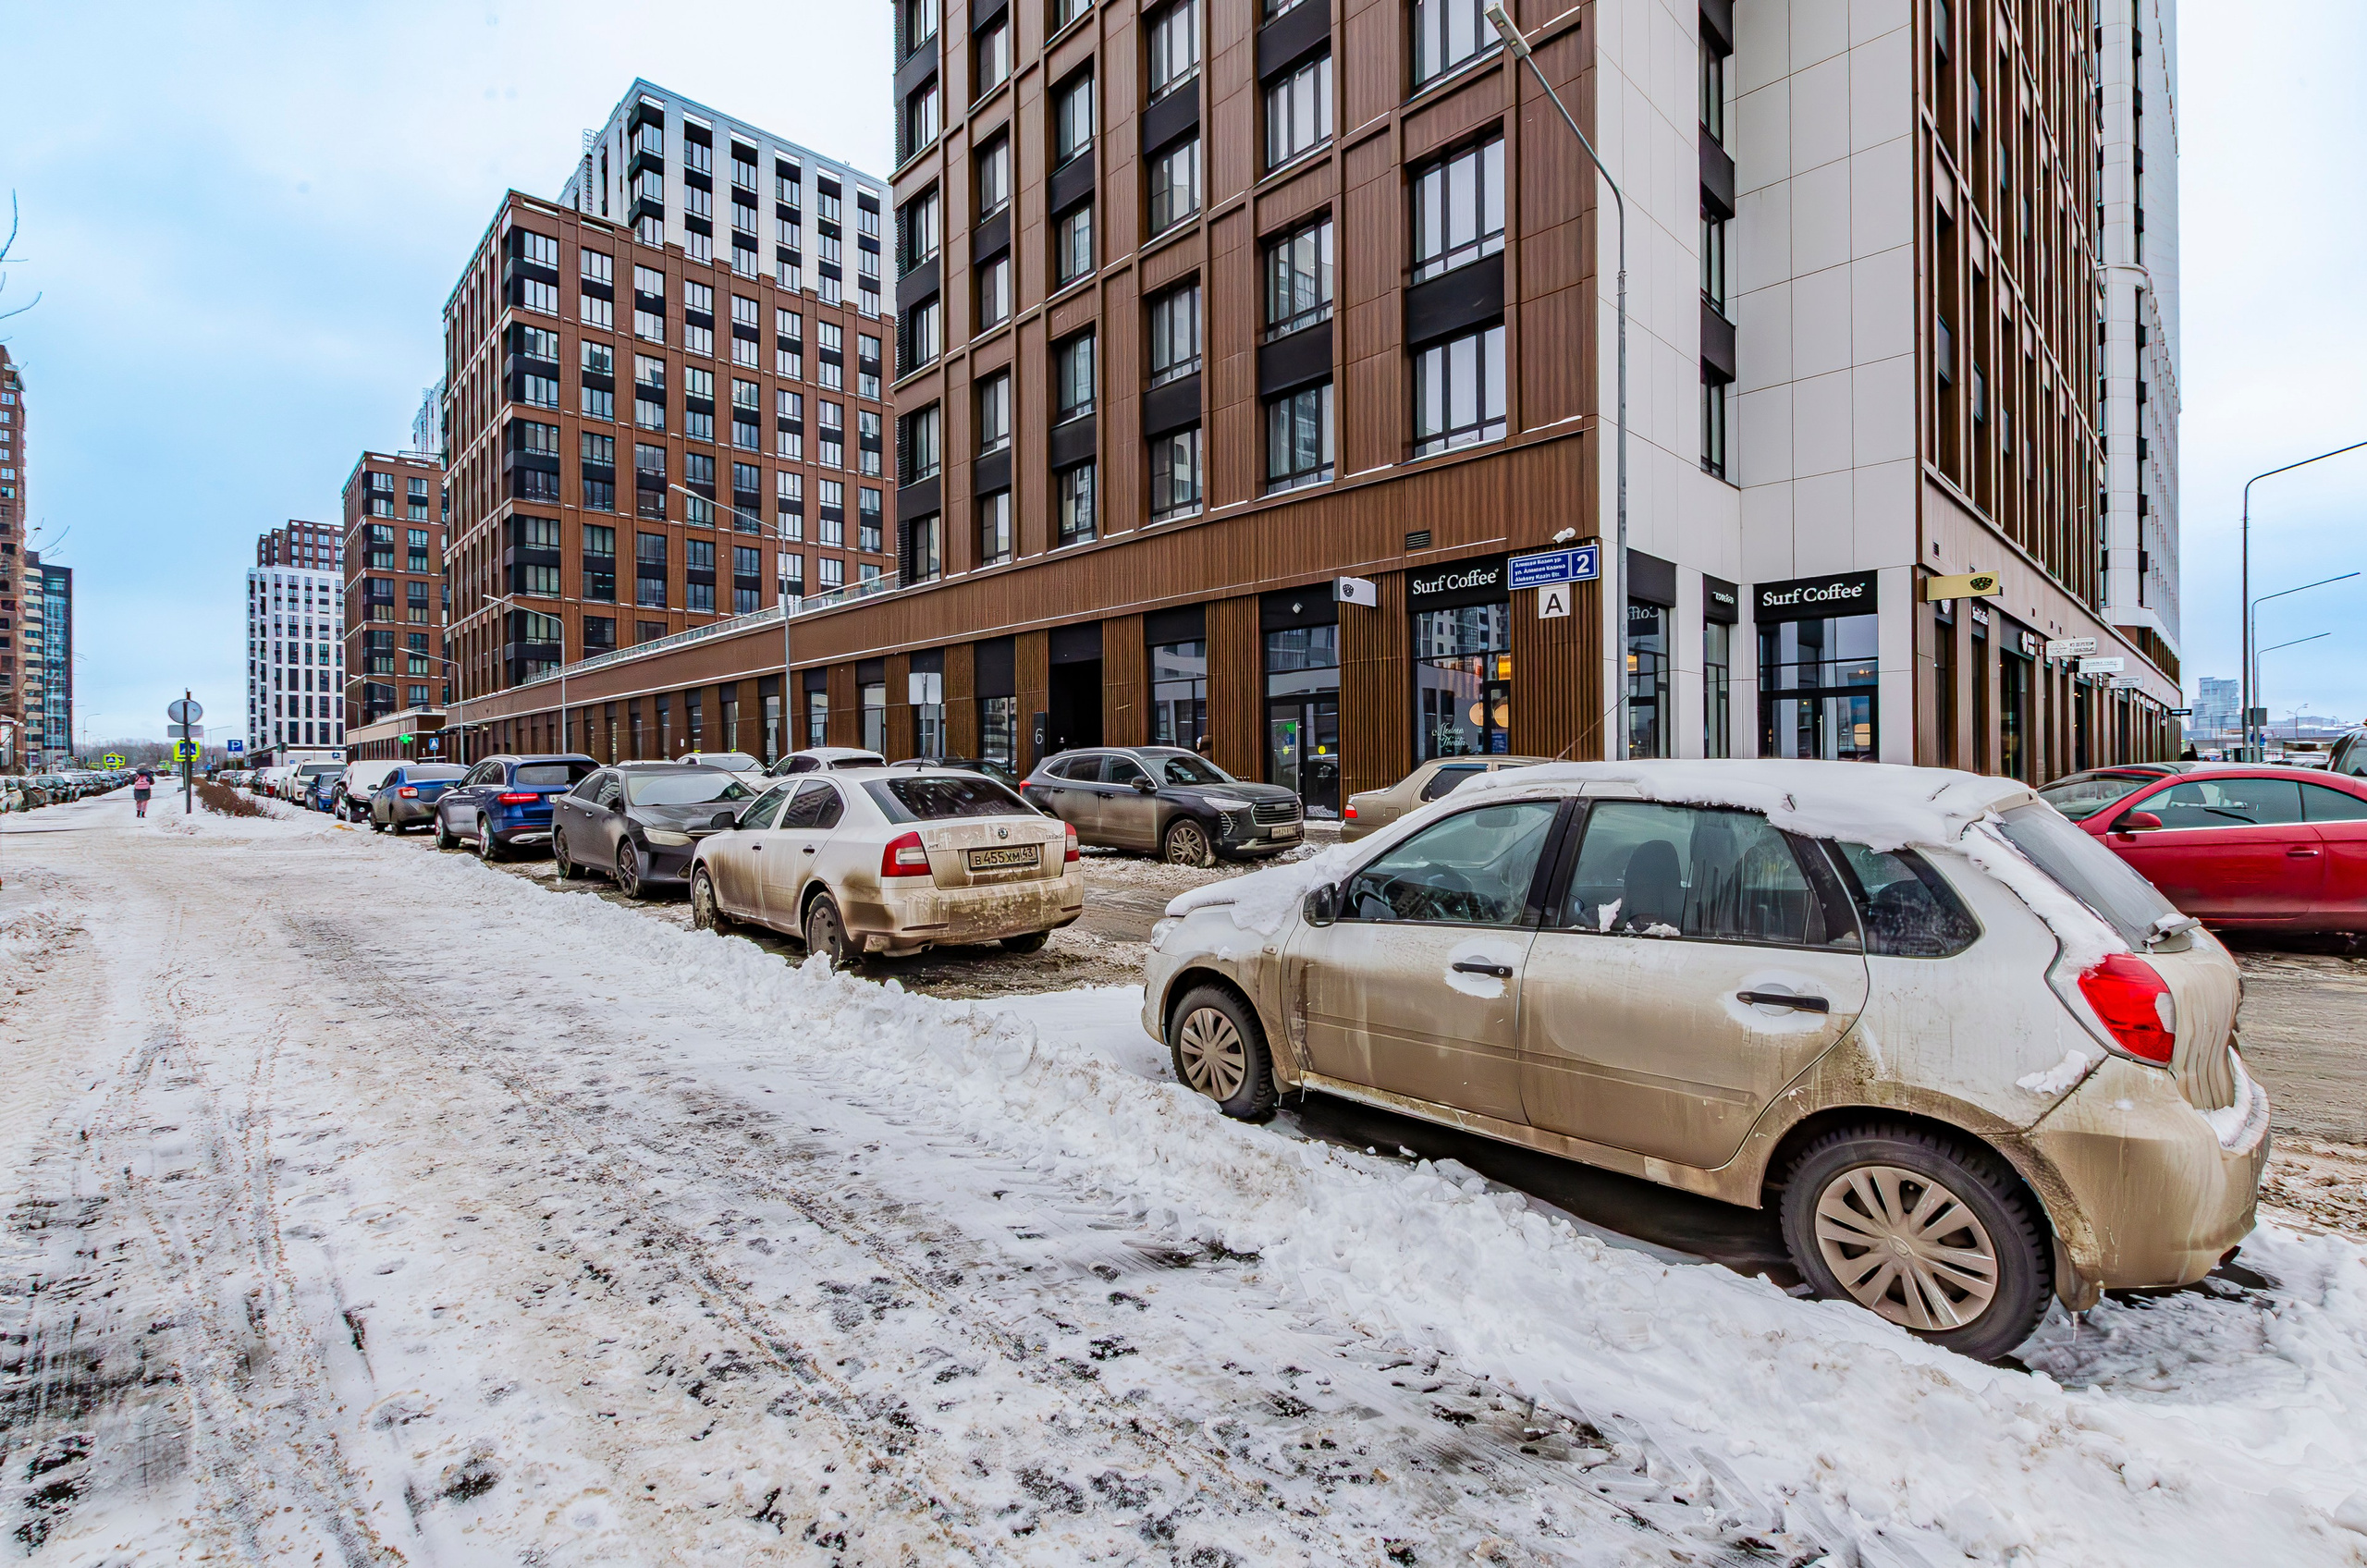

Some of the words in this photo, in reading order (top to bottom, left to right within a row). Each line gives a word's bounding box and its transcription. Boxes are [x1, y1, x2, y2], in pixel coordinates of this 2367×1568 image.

[1576, 554, 1589, 573] 2
[1413, 575, 1446, 594] Surf
[1447, 569, 1497, 590] Coffee
[1762, 588, 1802, 606] Surf
[1803, 582, 1863, 602] Coffee
[231, 741, 240, 751] P
[1036, 728, 1043, 745] 6
